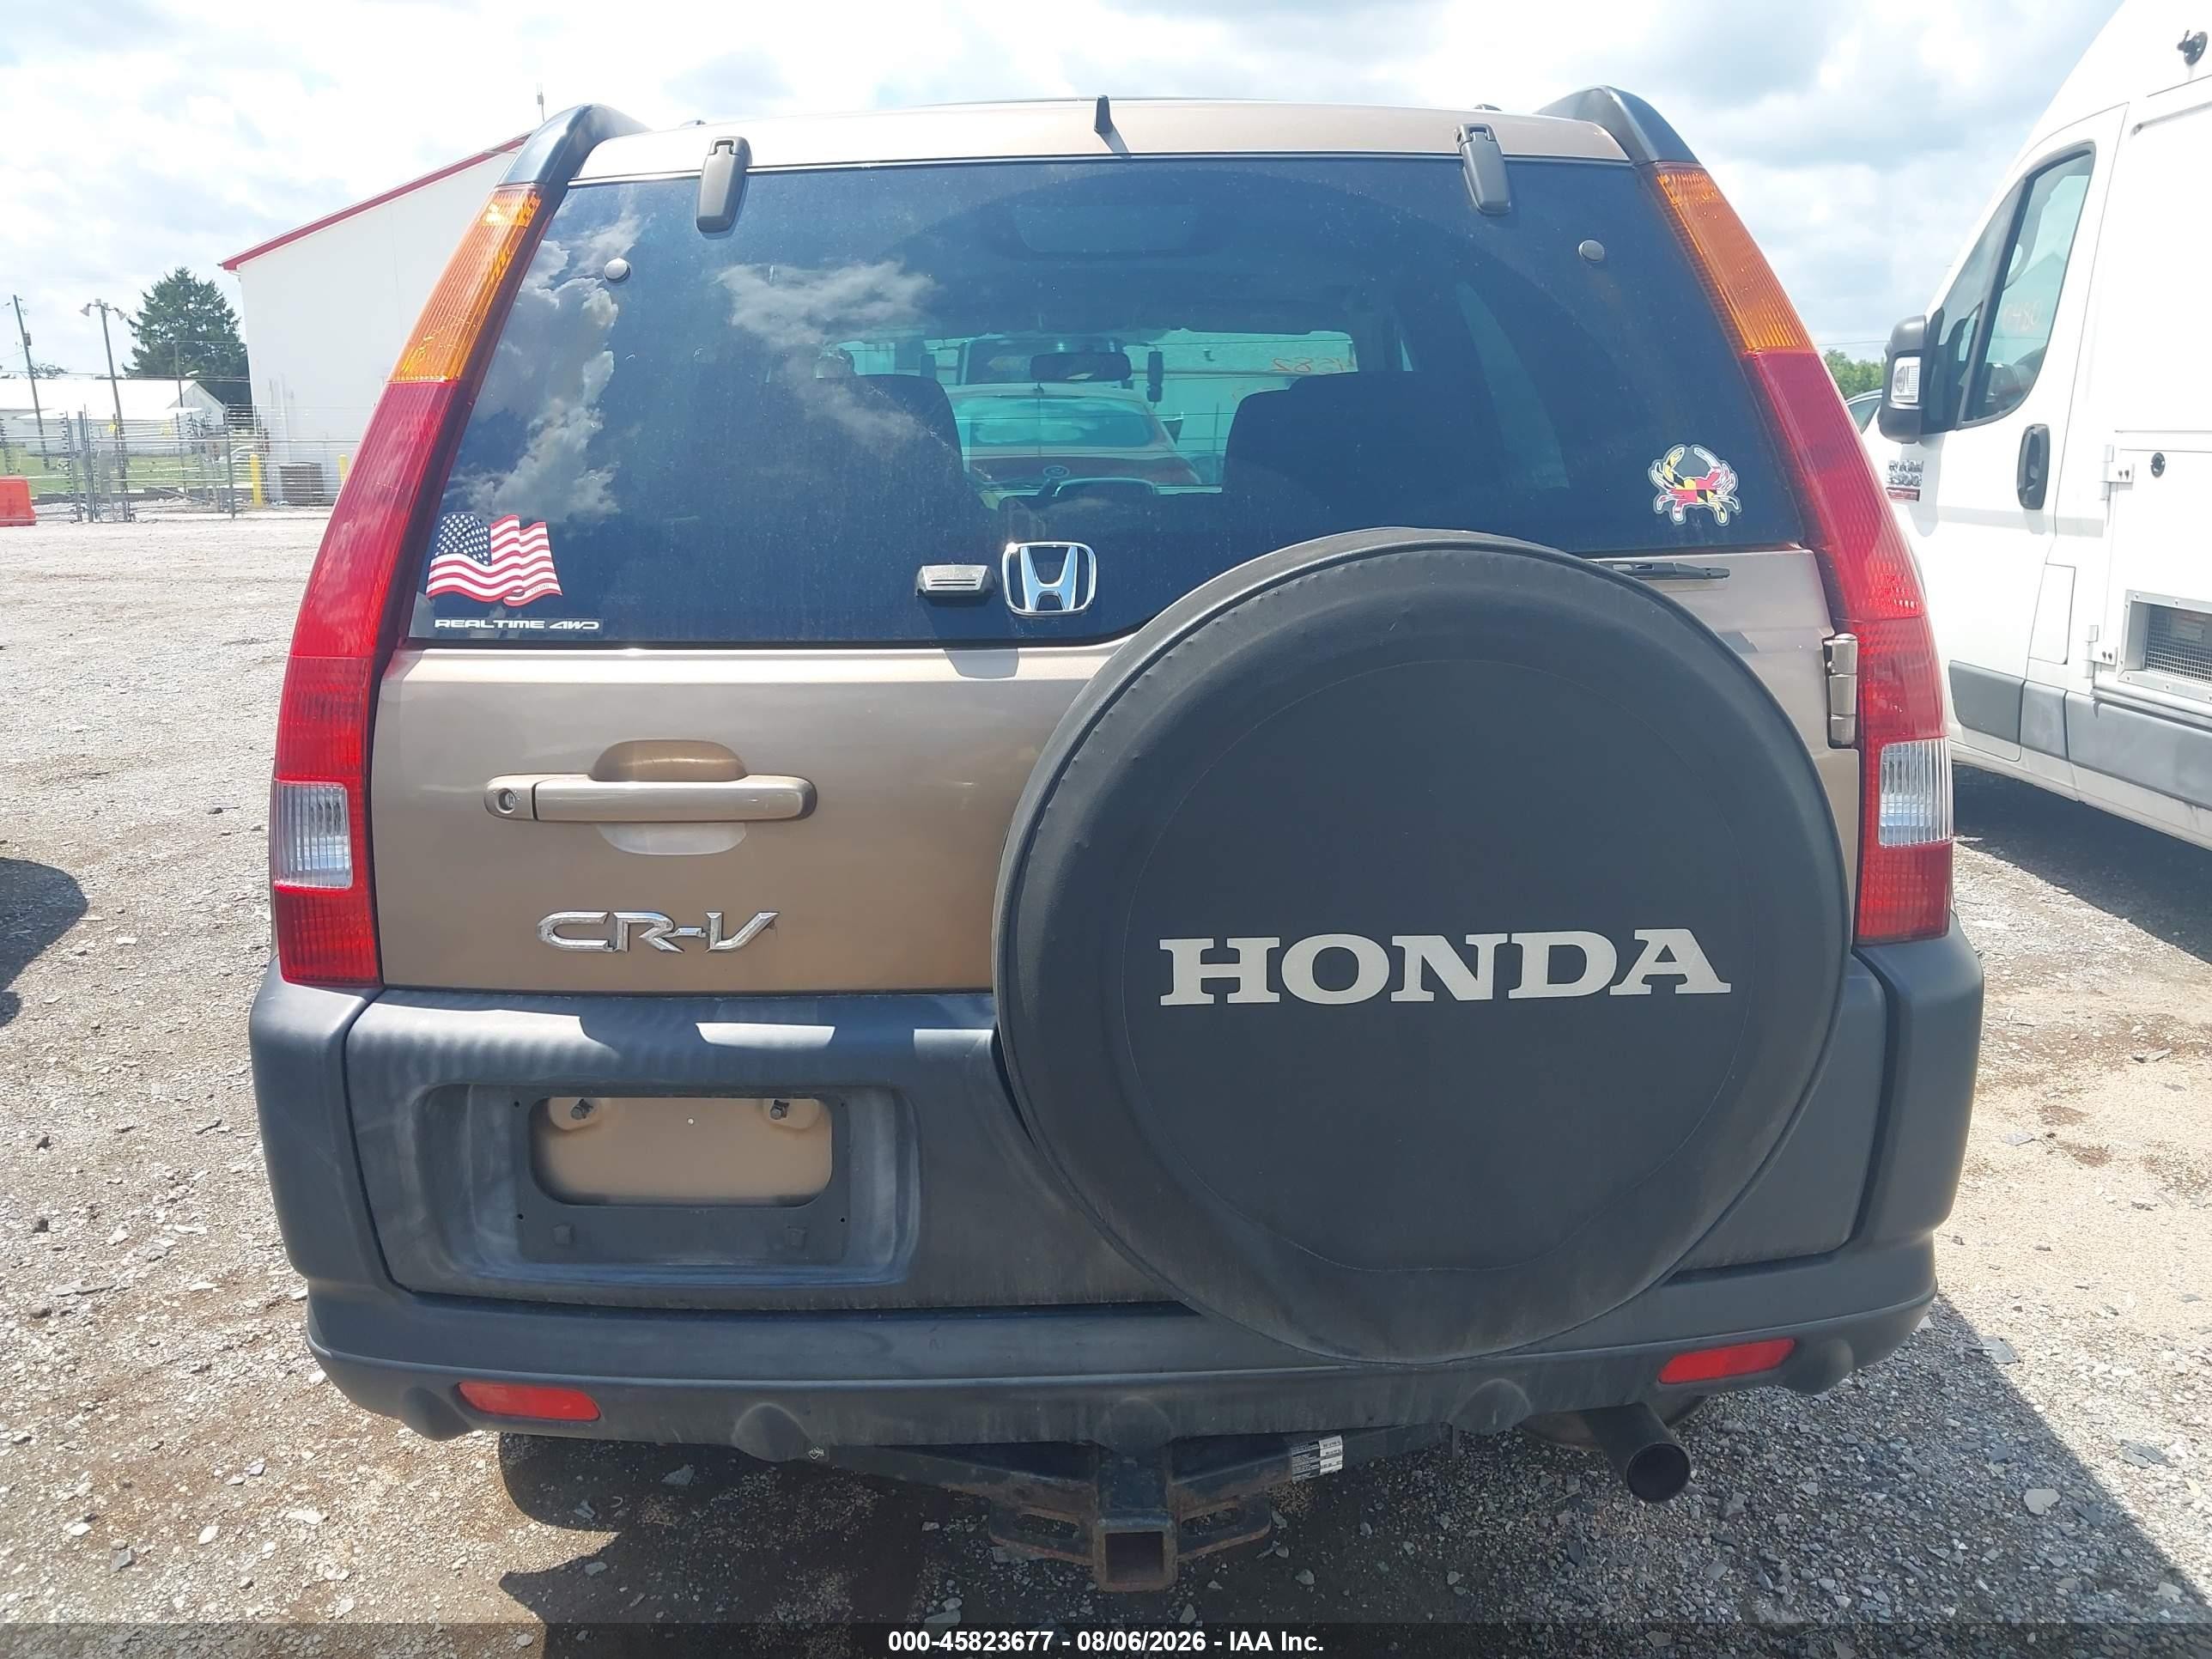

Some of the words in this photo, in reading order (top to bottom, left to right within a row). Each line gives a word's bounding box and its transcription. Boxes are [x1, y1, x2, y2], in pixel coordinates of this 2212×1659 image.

[549, 620, 599, 630] 4WD
[536, 911, 779, 952] CR-V
[1159, 928, 1732, 1006] HONDA
